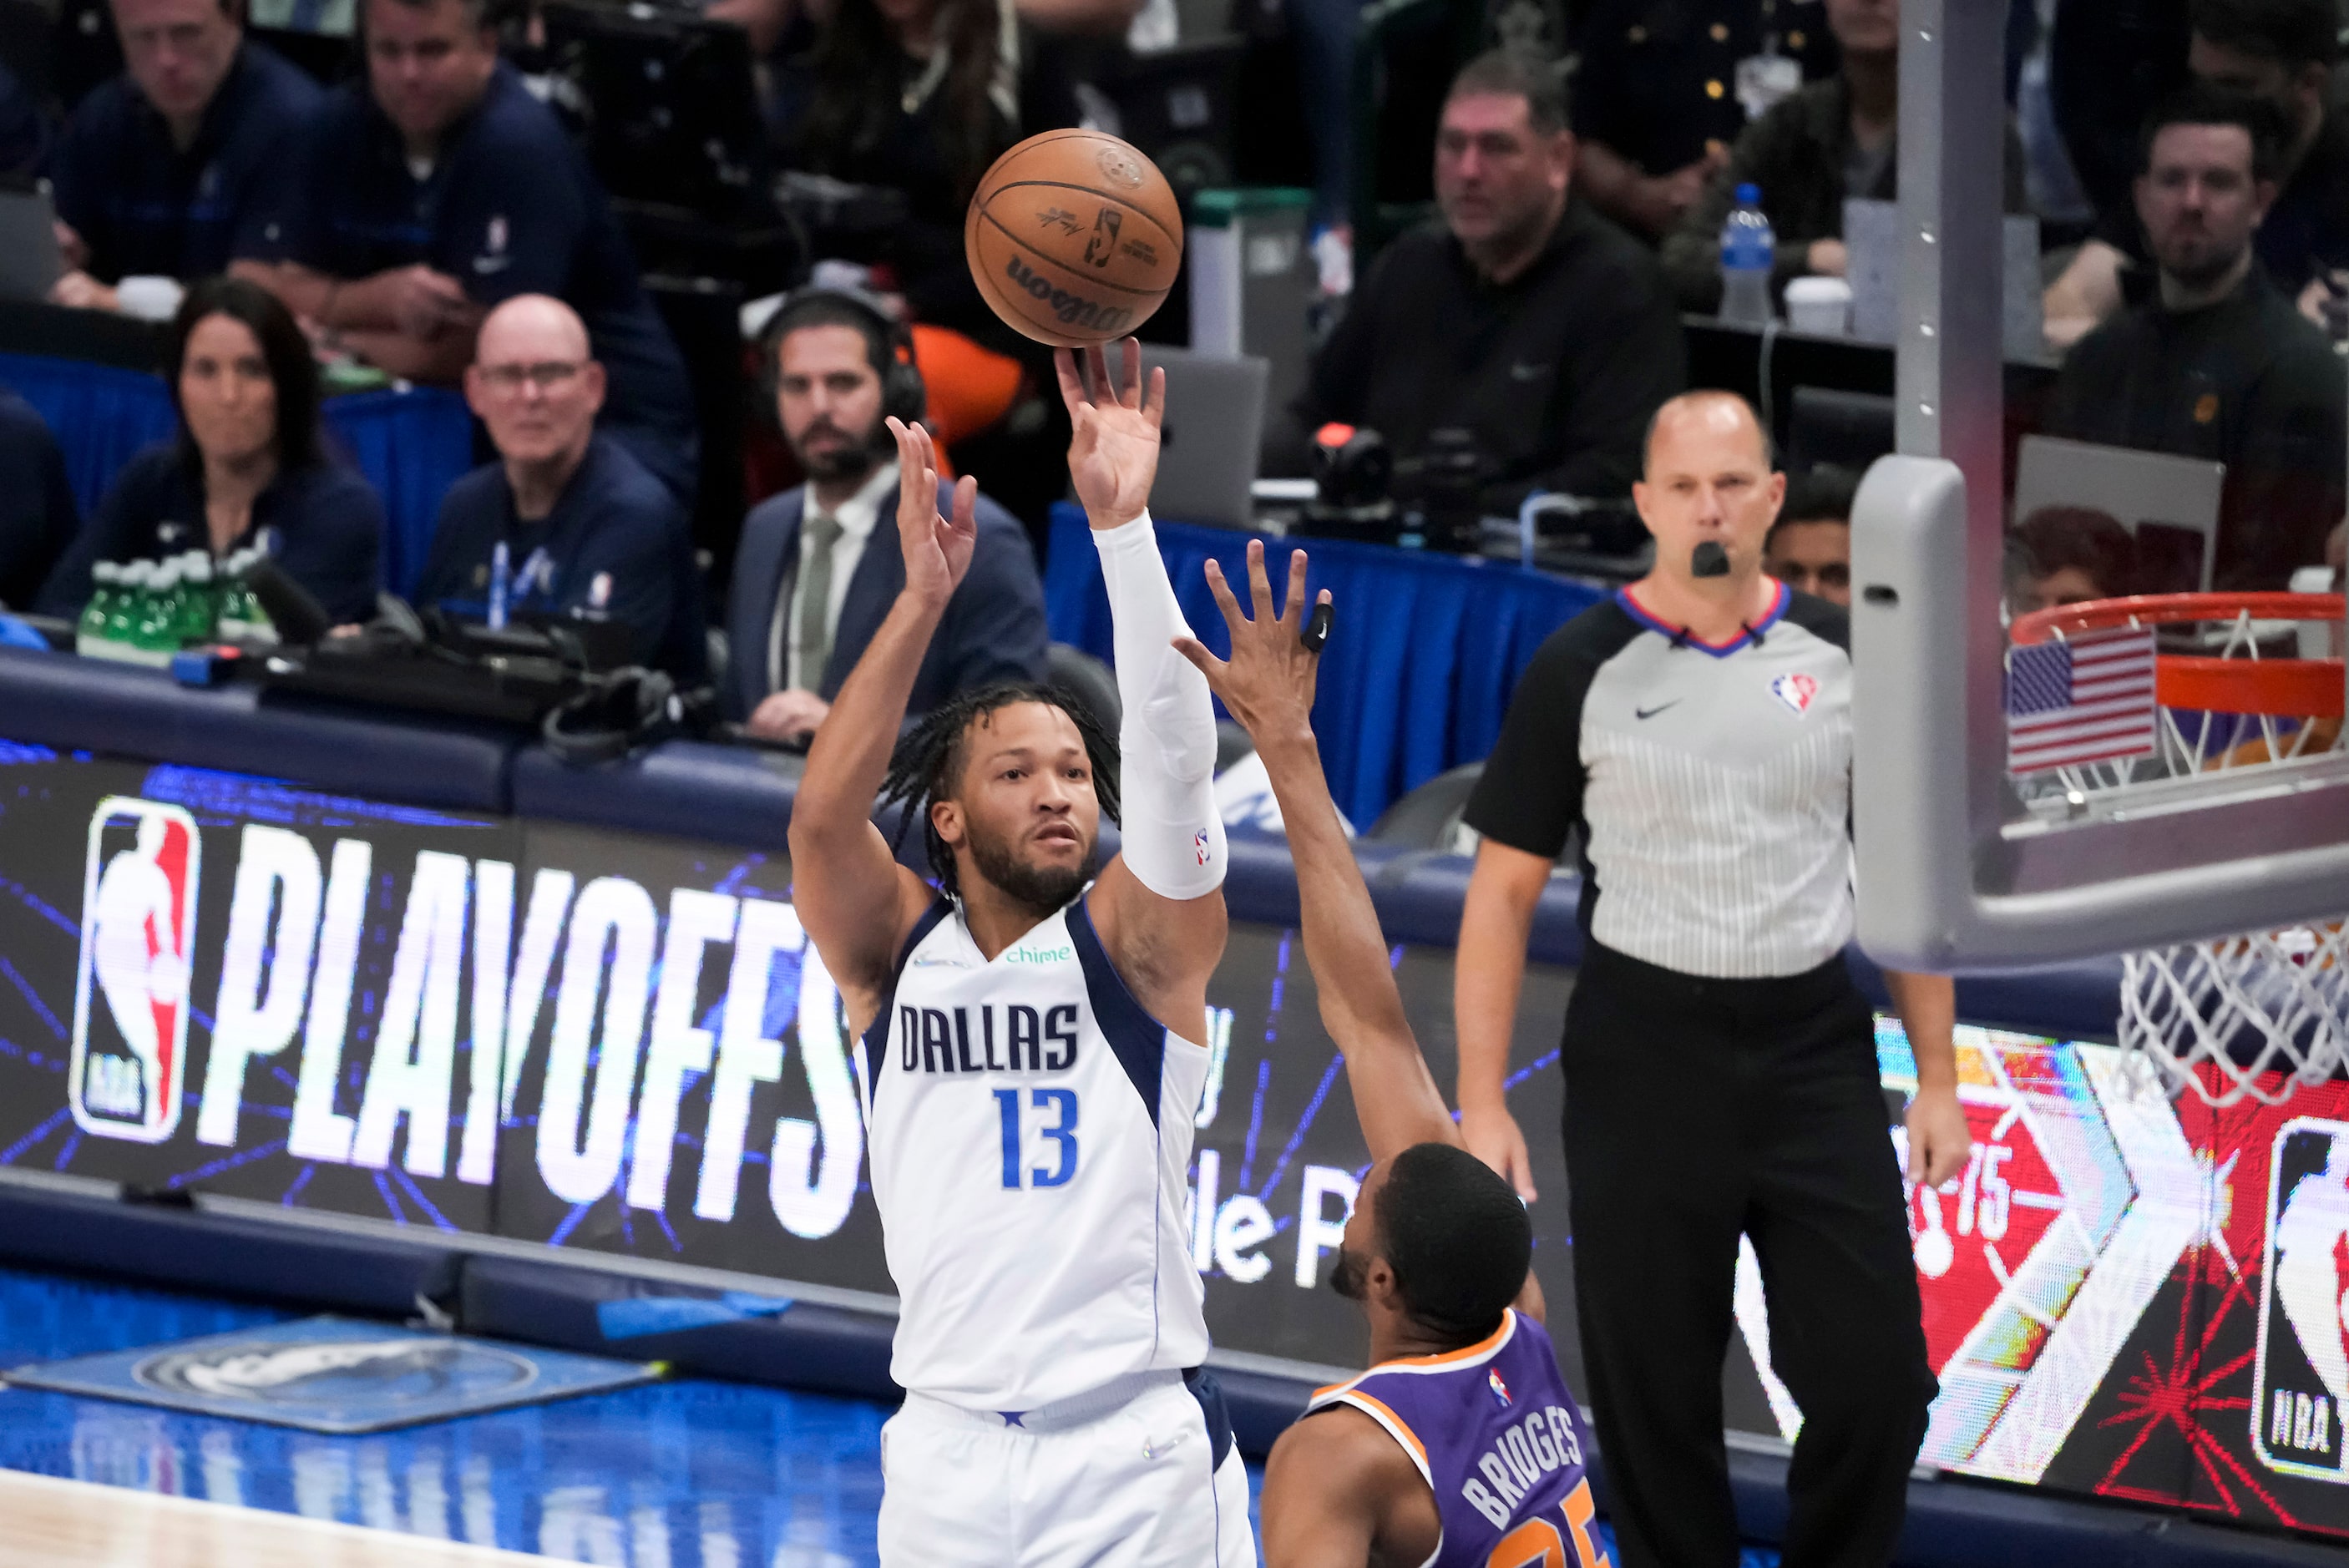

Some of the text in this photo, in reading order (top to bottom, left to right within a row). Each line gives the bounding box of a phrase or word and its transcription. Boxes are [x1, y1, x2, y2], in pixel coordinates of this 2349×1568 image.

[1006, 253, 1134, 331] Wilson
[1005, 945, 1071, 965] chime
[195, 822, 862, 1241] PLAYOFFS
[899, 1004, 1080, 1074] DALLAS
[990, 1087, 1080, 1191] 13
[2271, 1388, 2331, 1454] NBA
[1461, 1405, 1583, 1531] BRIDGES
